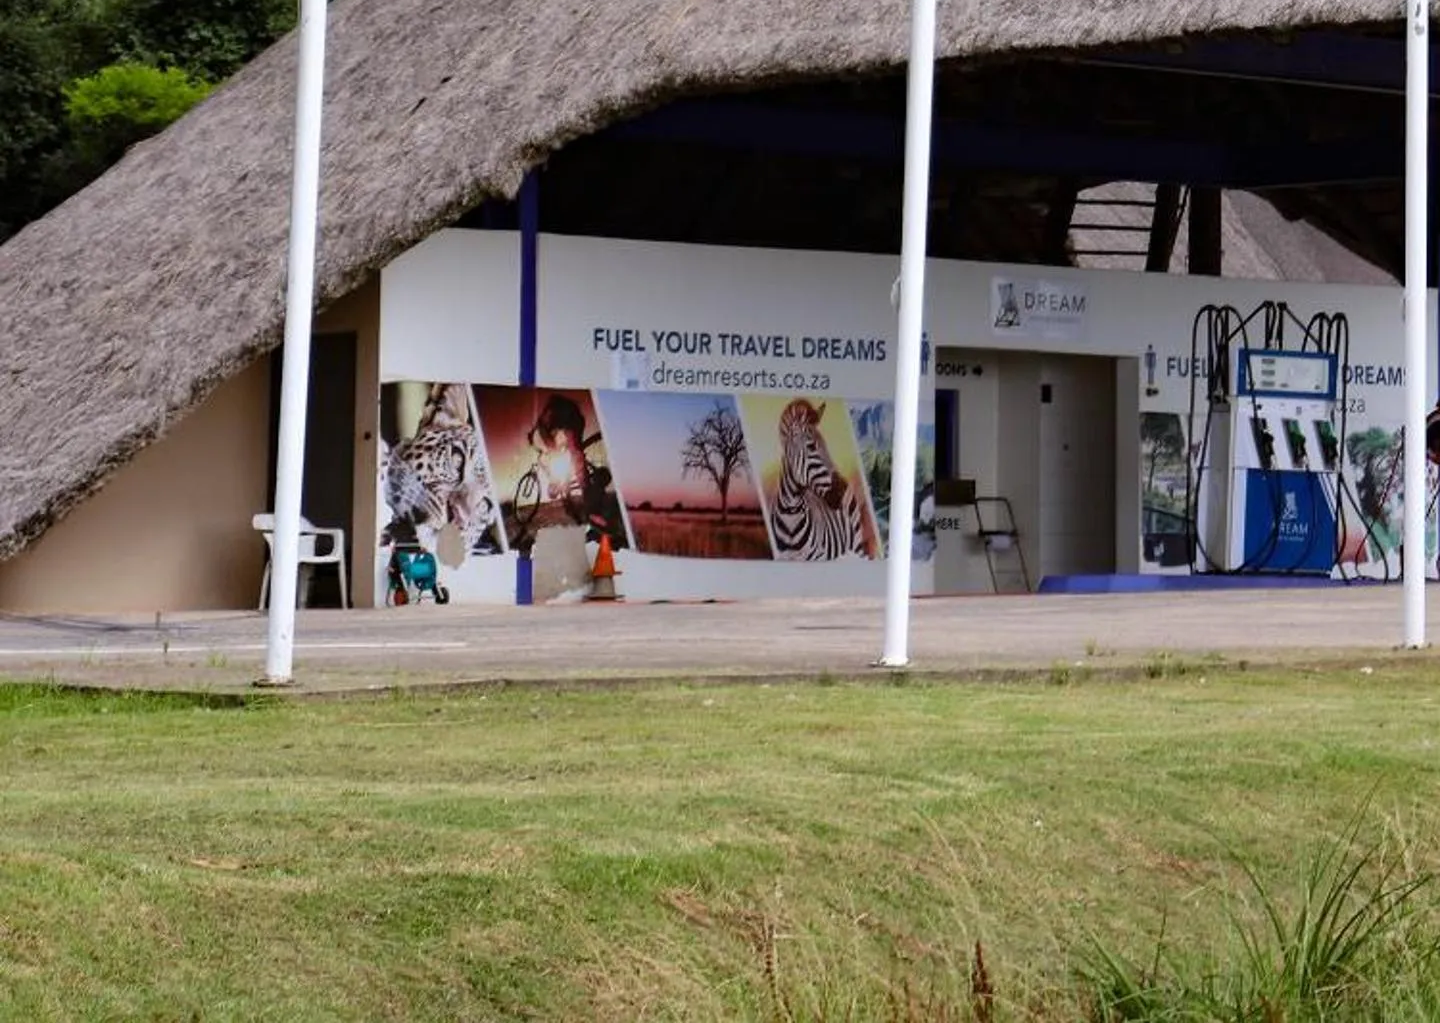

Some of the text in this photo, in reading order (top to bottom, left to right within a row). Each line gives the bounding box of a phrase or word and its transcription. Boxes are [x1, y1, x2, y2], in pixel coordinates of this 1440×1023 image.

[1024, 291, 1087, 313] DREAM
[593, 327, 887, 362] FUEL YOUR TRAVEL DREAMS
[652, 360, 831, 391] dreamresorts.co.za
[1166, 355, 1406, 387] FUEL DREAM
[1273, 521, 1309, 535] REAM
